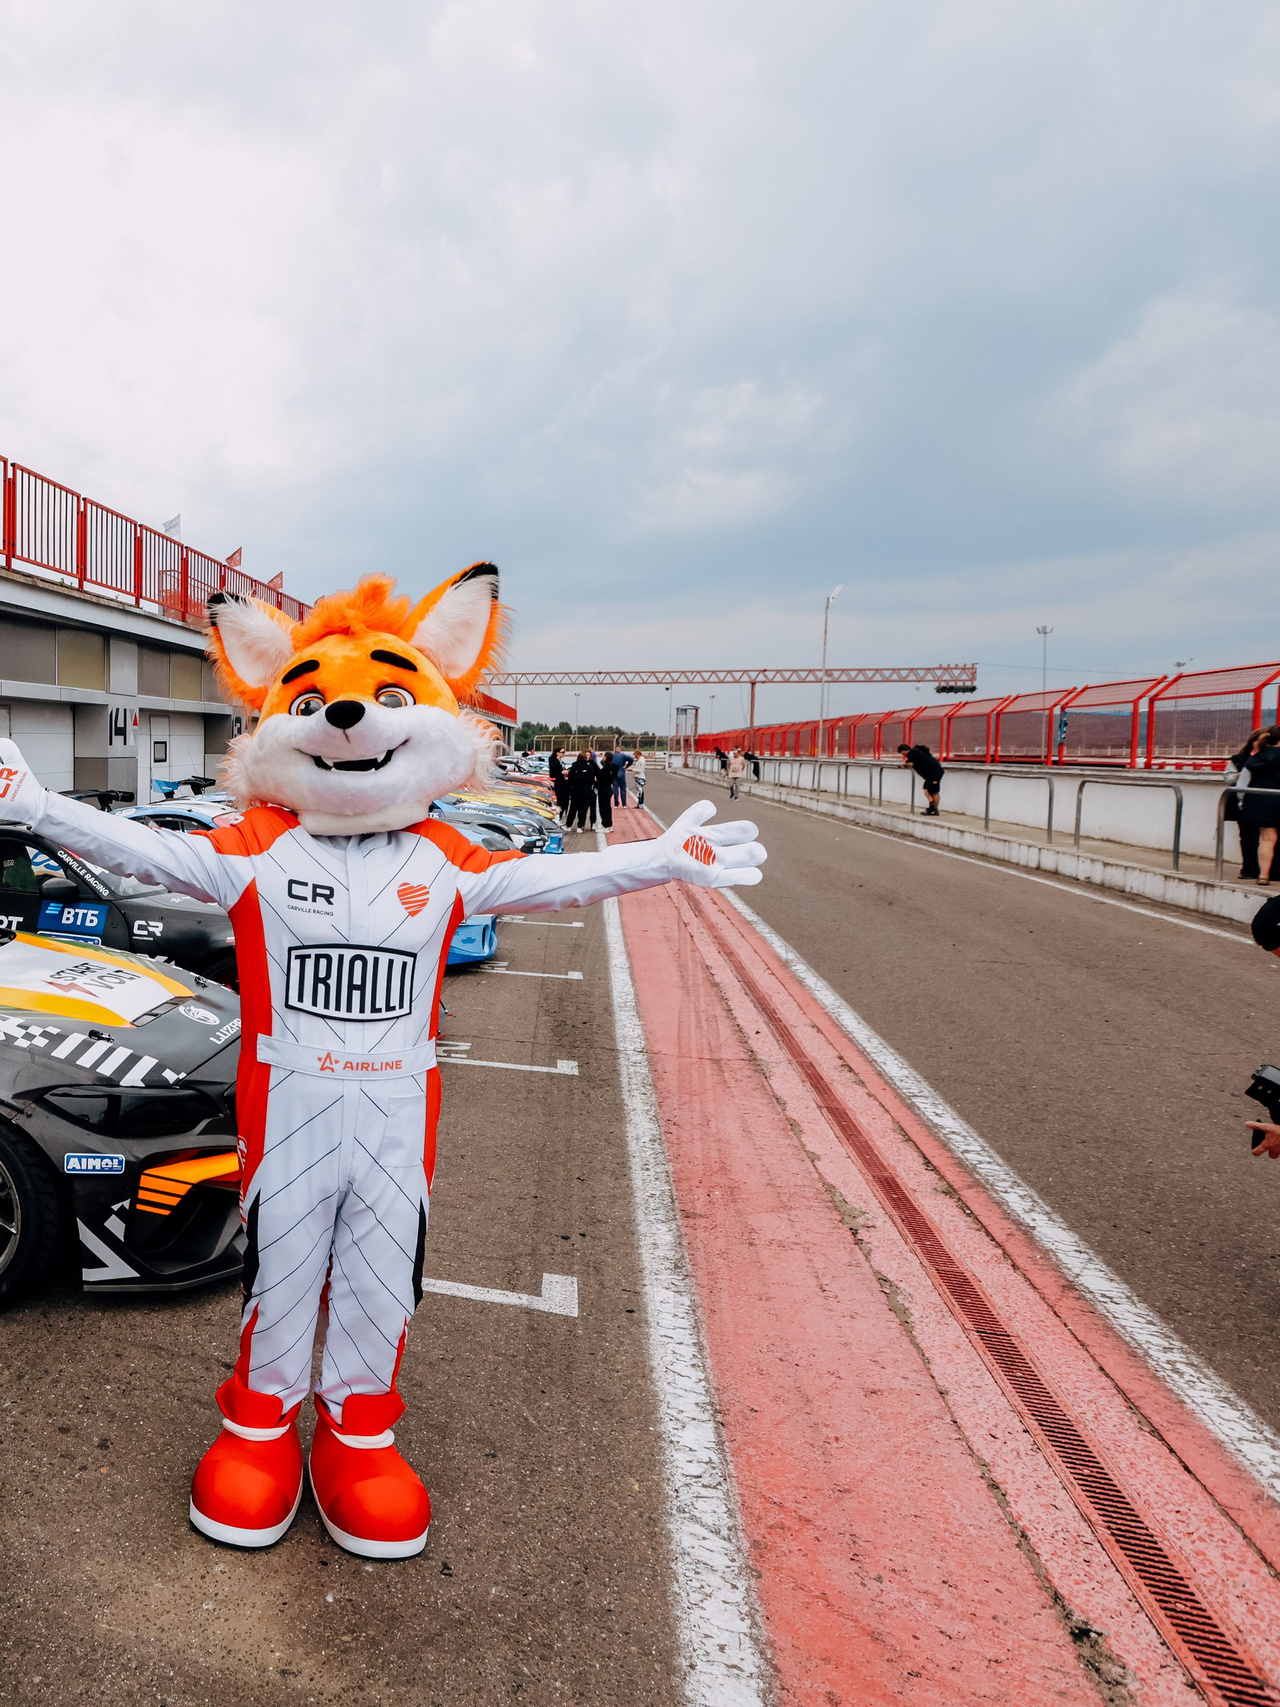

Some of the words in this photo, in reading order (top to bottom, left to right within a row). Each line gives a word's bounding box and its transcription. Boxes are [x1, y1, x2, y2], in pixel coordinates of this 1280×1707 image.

[109, 708, 128, 746] 14
[57, 850, 86, 877] CARVILLE
[84, 873, 110, 897] RACING
[287, 878, 335, 906] CR
[61, 908, 100, 927] ВТБ
[287, 904, 312, 914] CARVILLE
[312, 908, 334, 917] RACING
[133, 919, 164, 937] CR
[49, 962, 107, 982] START
[83, 969, 142, 990] VOLT
[294, 952, 408, 1014] TRIALLI
[342, 1059, 403, 1072] AIRLINE
[67, 1157, 122, 1171] AIMOL
